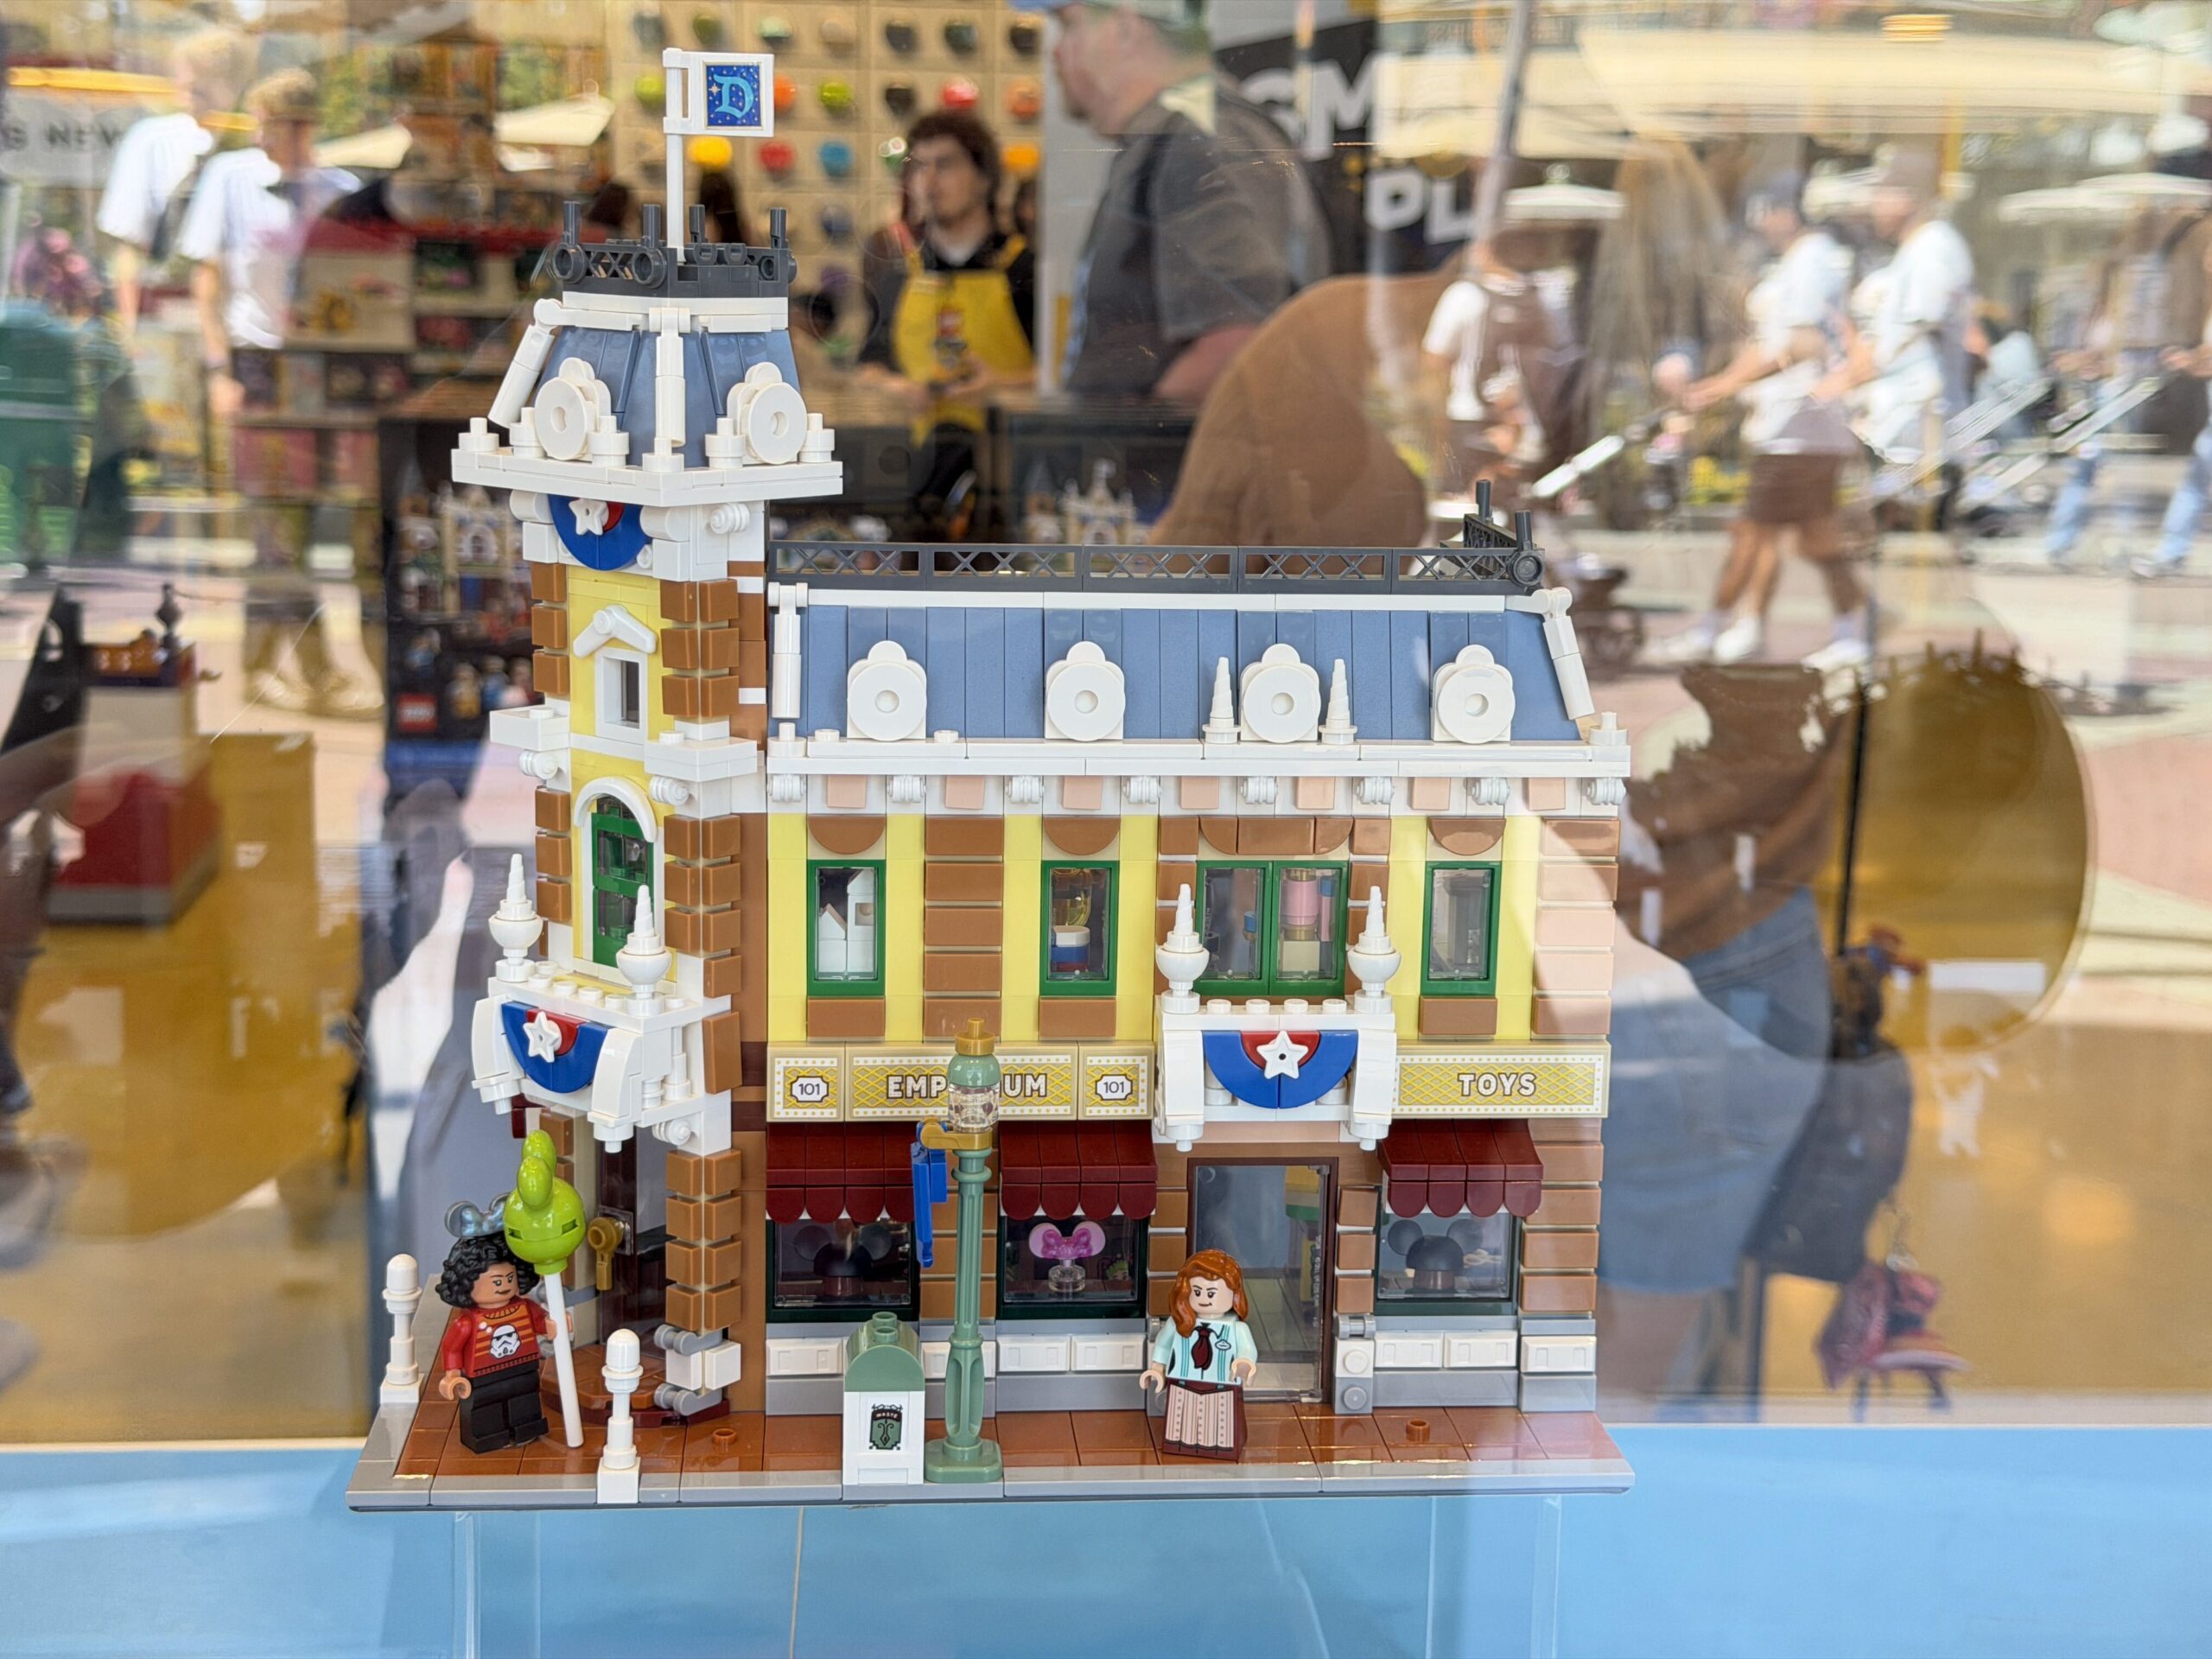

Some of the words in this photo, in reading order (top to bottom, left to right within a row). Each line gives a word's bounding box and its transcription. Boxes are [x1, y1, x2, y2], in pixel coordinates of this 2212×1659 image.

[713, 73, 754, 118] D
[798, 1083, 820, 1096] 101
[887, 1073, 1047, 1098] EMPUM
[1103, 1080, 1125, 1094] 101
[1458, 1072, 1537, 1096] TOYS
